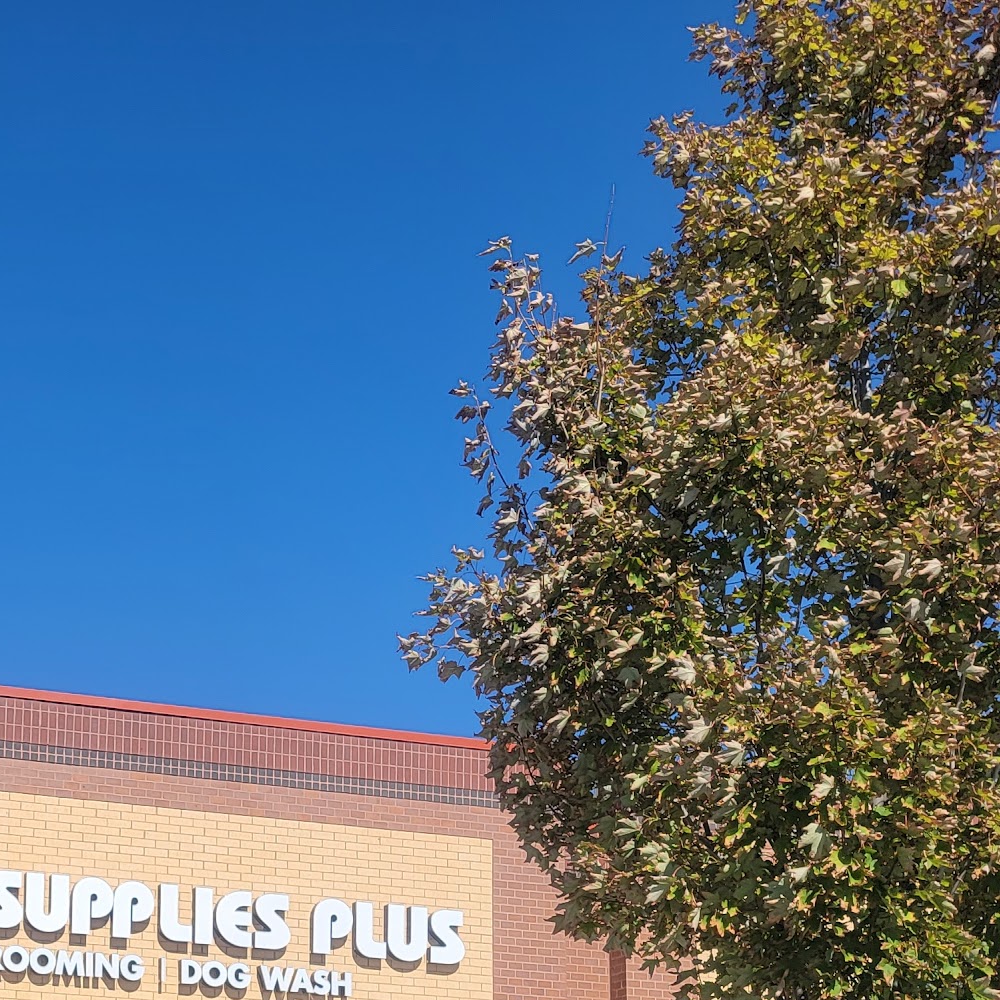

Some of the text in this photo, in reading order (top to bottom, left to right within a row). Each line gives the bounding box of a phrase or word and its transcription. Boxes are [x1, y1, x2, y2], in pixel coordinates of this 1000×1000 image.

[311, 898, 467, 965] PLUS
[179, 958, 251, 990] DOG
[259, 963, 353, 998] WASH
